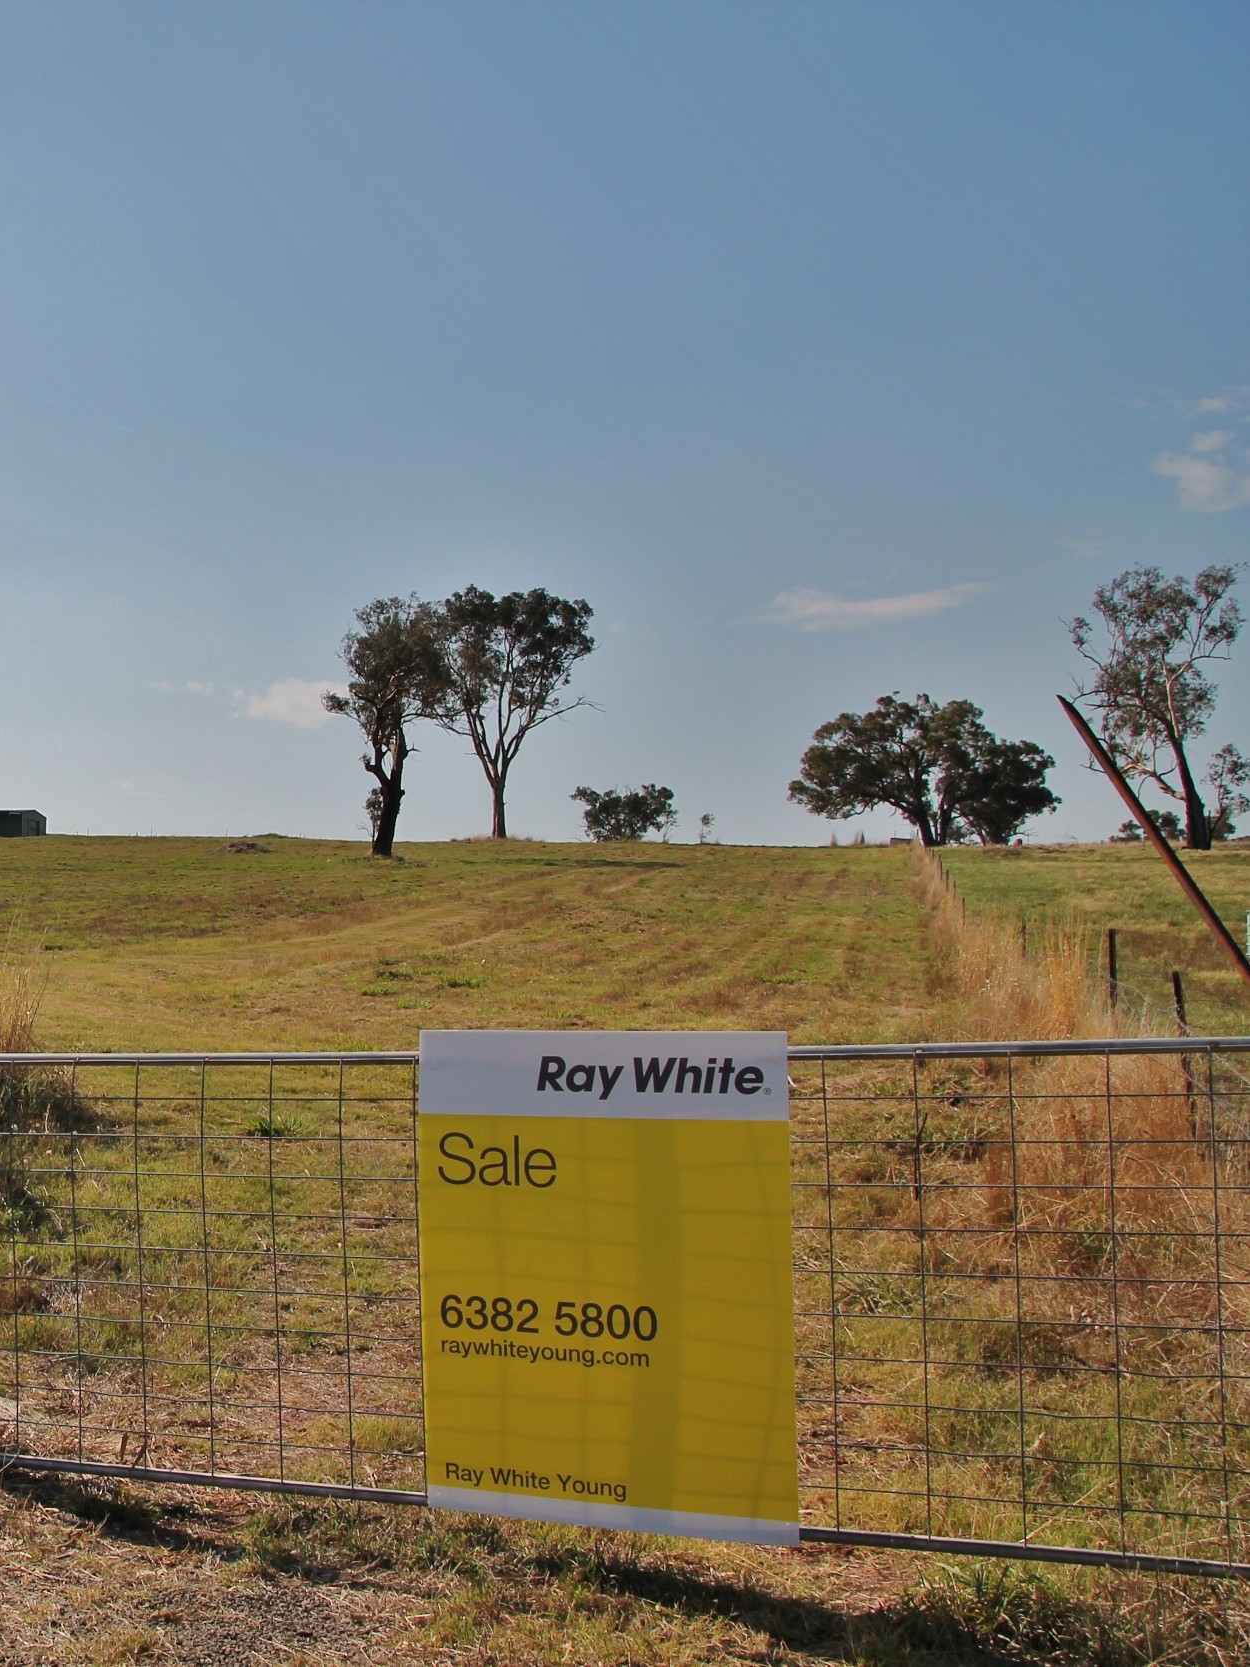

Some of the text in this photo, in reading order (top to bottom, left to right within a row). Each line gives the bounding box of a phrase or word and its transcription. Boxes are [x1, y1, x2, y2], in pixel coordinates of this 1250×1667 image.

[536, 1055, 764, 1100] Ray White
[438, 1132, 557, 1188] Sale
[440, 1294, 658, 1342] 6382 5800
[440, 1338, 650, 1368] raywhiteyoung.com
[445, 1462, 627, 1502] Ray White Young
